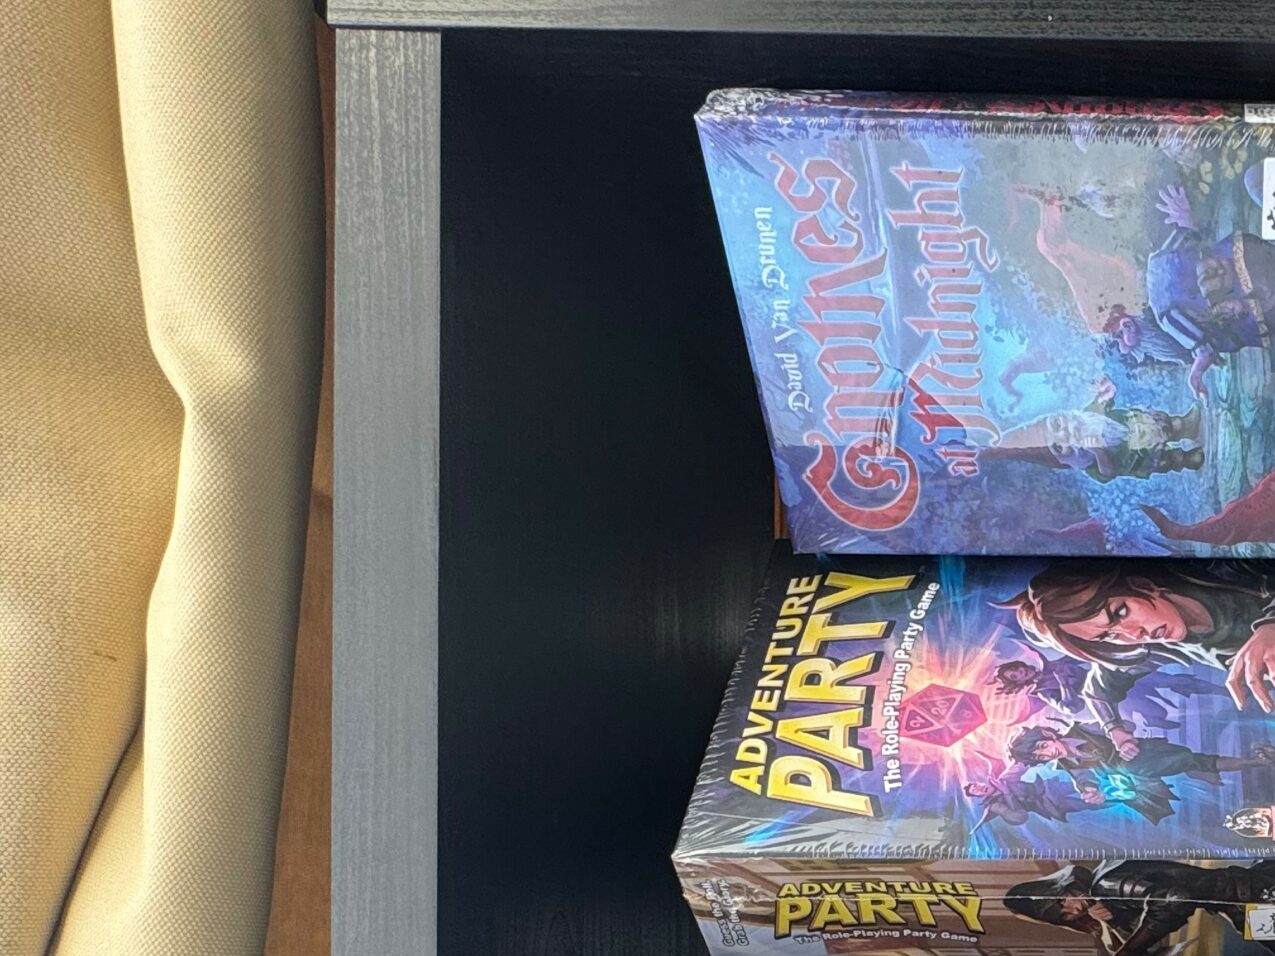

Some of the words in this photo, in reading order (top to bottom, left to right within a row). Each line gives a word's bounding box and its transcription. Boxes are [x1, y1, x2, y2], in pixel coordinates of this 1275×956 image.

[753, 206, 787, 290] Drunen
[768, 298, 800, 344] Van
[885, 165, 1000, 446] Midnight
[767, 152, 921, 532] Gnomes
[775, 353, 812, 412] David
[938, 445, 979, 477] at
[908, 582, 940, 620] Game
[894, 622, 924, 659] Party
[730, 573, 823, 795] ADVENTURE
[766, 571, 918, 817] PARTY
[881, 663, 912, 756] Role-Playing
[884, 759, 903, 792] The
[711, 902, 722, 918] the
[777, 881, 978, 898] ADVENTURE
[716, 919, 734, 946] Guess
[732, 924, 750, 946] Grab
[774, 893, 985, 937] PARTY
[792, 934, 820, 944] The
[822, 928, 900, 940] Role-Playing
[904, 928, 938, 940] Party
[940, 932, 978, 942] Game
